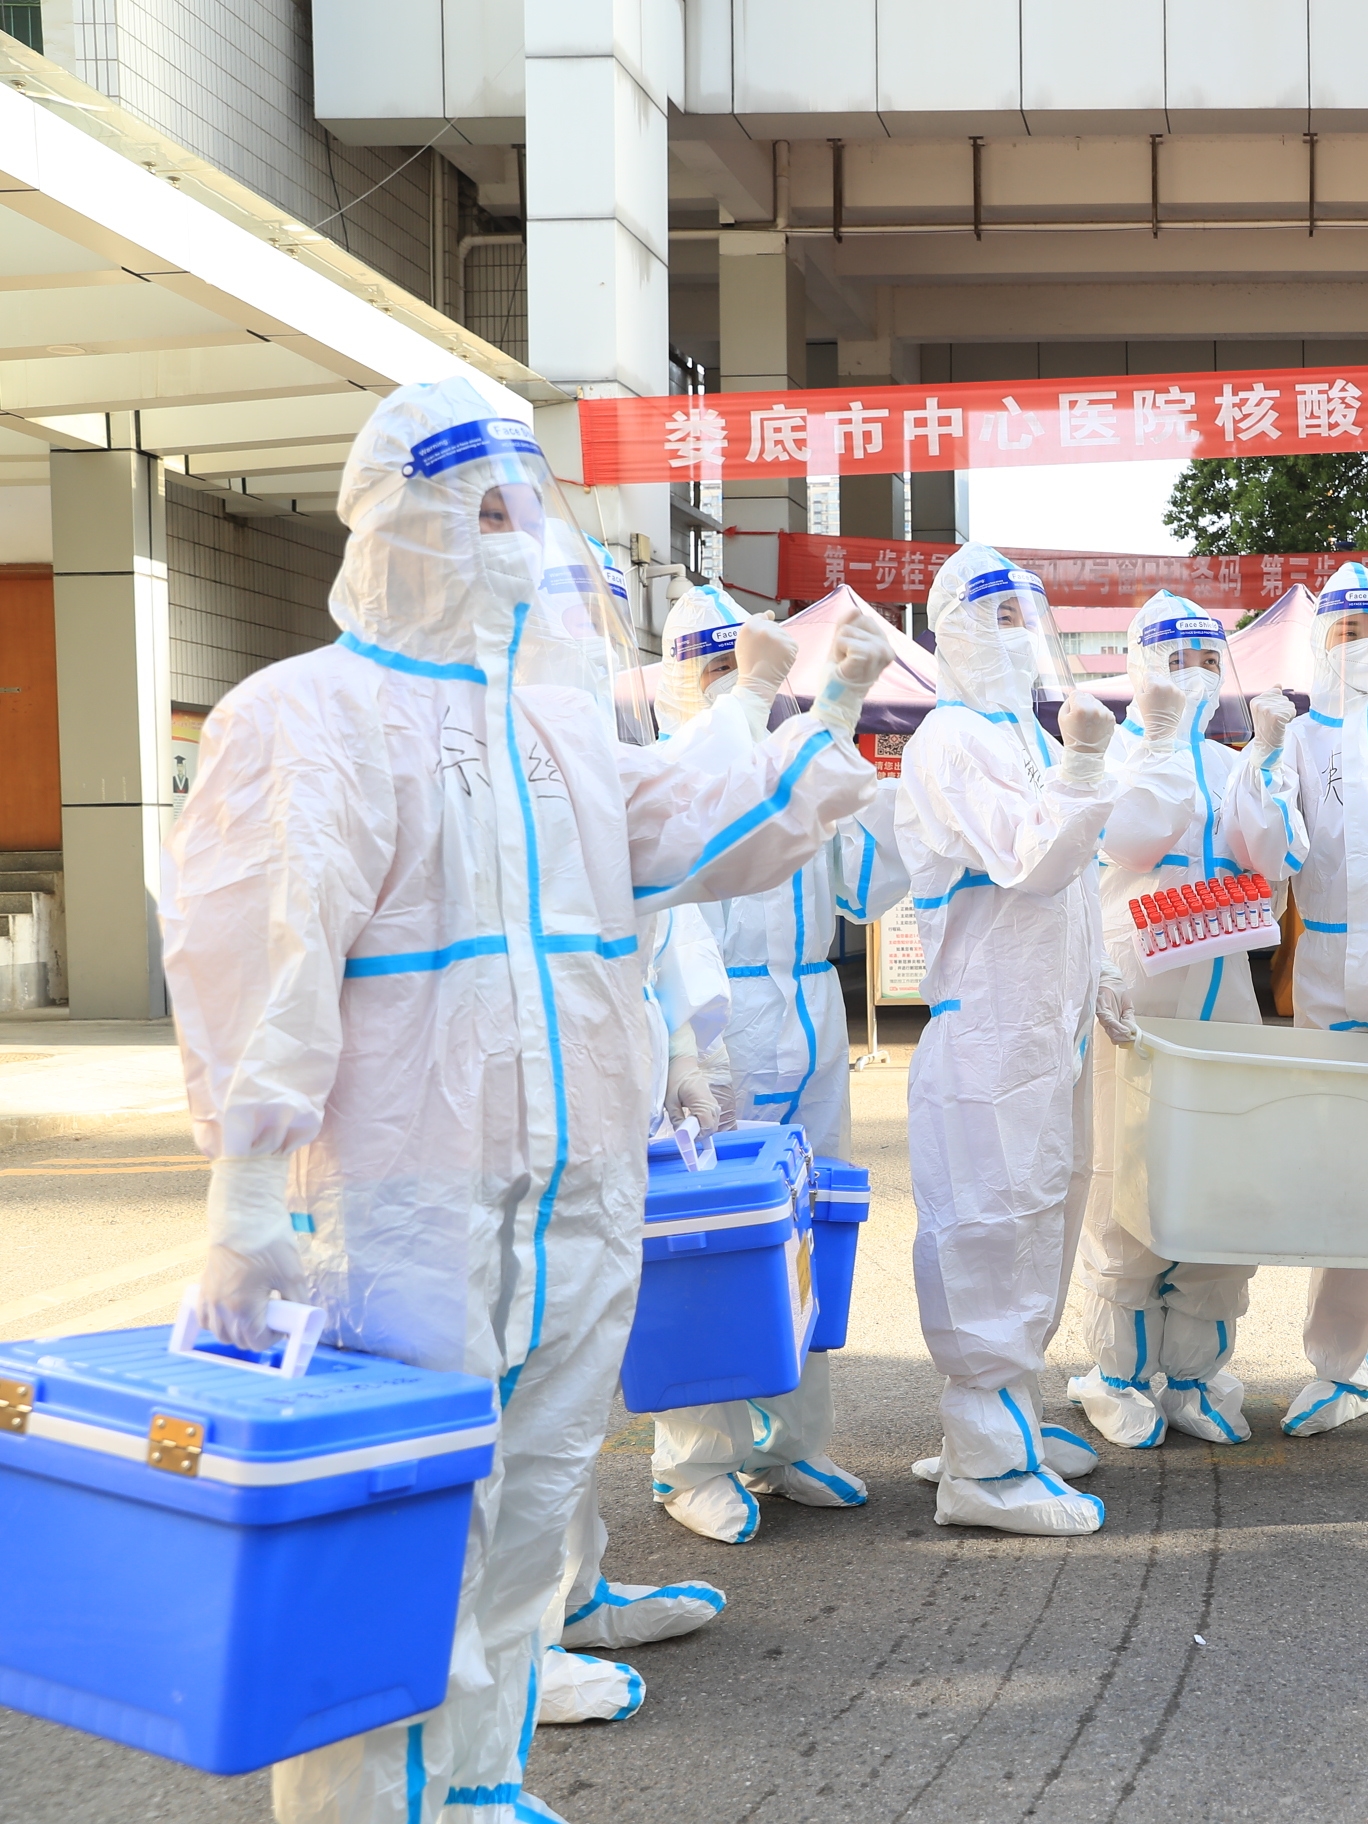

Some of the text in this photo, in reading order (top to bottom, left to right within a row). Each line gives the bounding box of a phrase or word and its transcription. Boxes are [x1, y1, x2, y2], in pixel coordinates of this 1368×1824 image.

[1349, 592, 1367, 600] Face
[1179, 621, 1218, 629] Face Shield
[716, 631, 738, 640] Face
